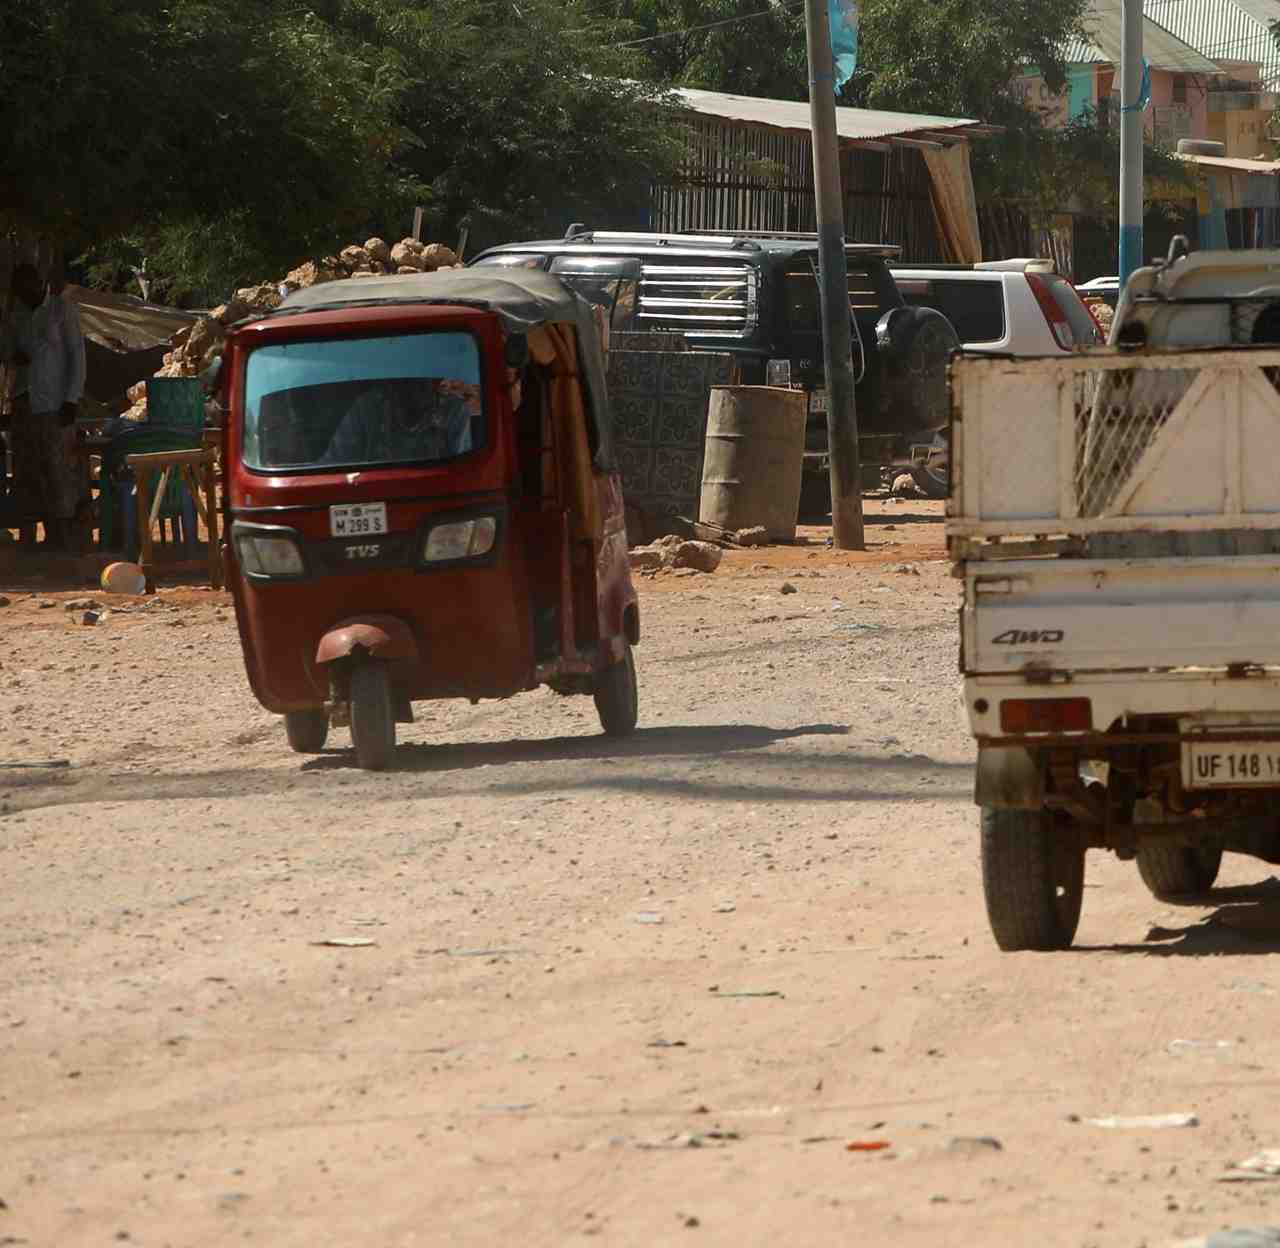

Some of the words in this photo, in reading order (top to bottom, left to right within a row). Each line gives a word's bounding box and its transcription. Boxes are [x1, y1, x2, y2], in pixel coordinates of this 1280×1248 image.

[345, 544, 380, 559] TVS
[990, 628, 1064, 646] 4WD
[1196, 754, 1223, 779] UF
[1227, 752, 1261, 779] 148
